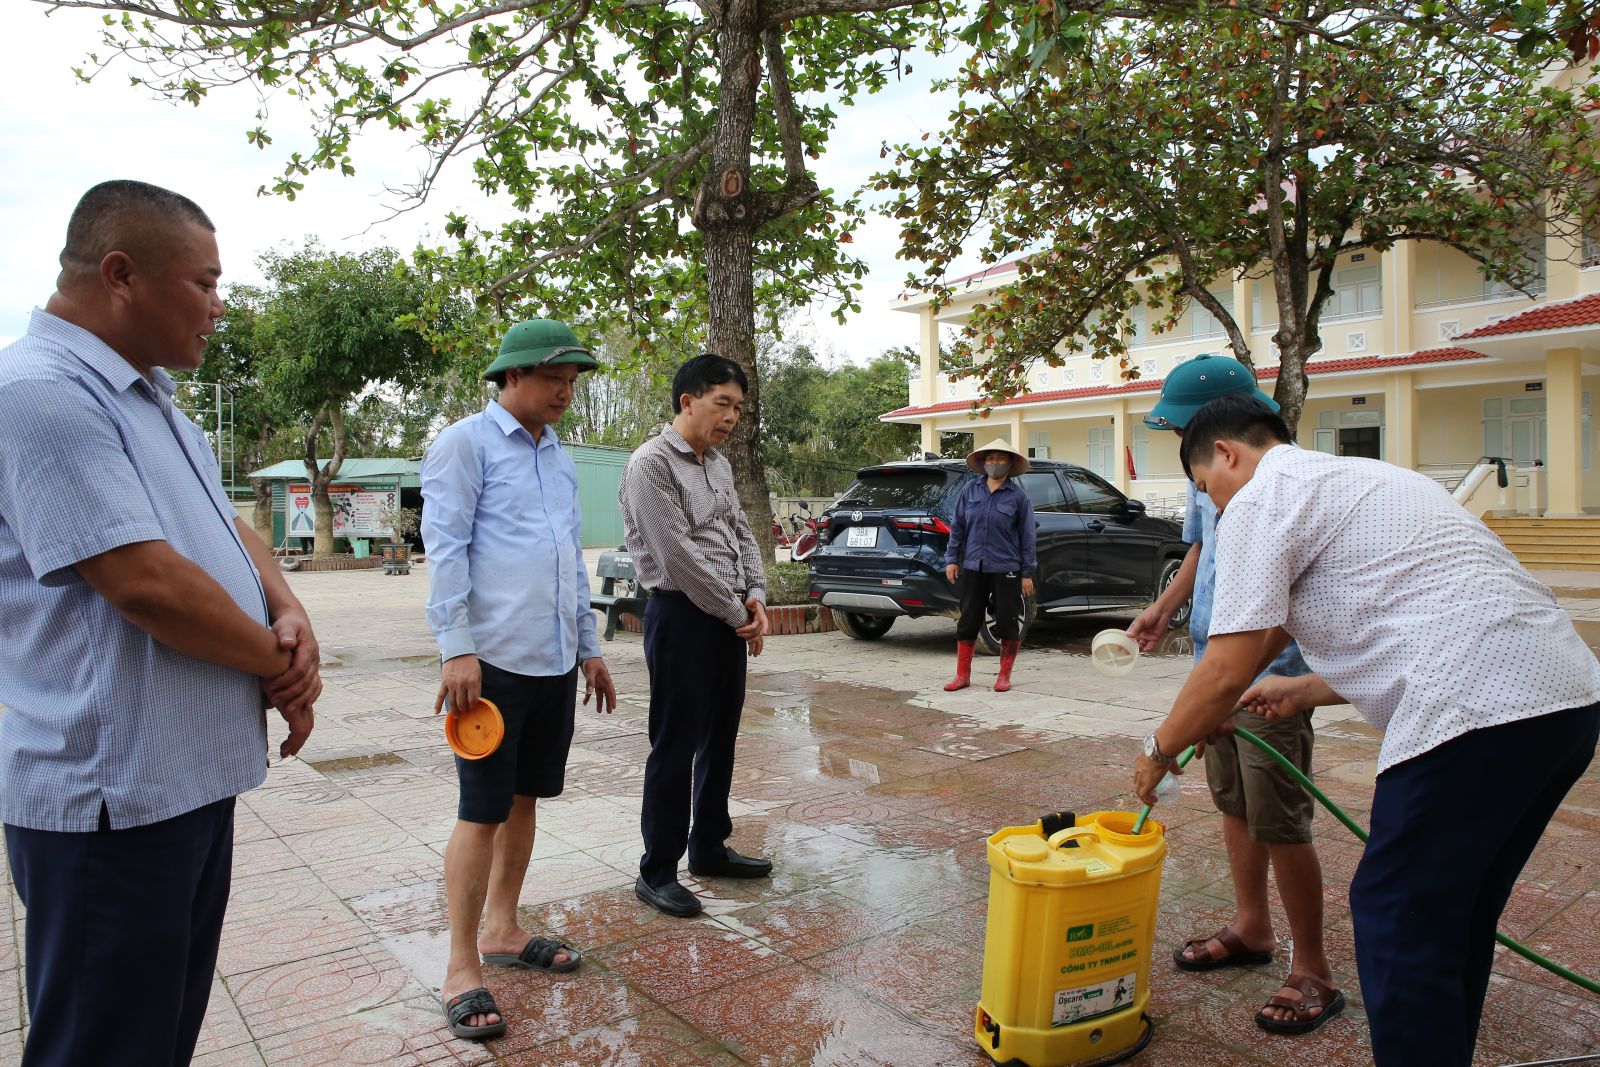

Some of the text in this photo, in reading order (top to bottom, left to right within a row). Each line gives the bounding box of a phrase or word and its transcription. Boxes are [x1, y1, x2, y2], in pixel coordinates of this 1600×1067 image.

[856, 528, 869, 537] 38A
[849, 537, 873, 546] 681.07
[1061, 962, 1086, 974] CÔNG
[1088, 960, 1098, 969] TY
[1100, 955, 1120, 966] TNHH
